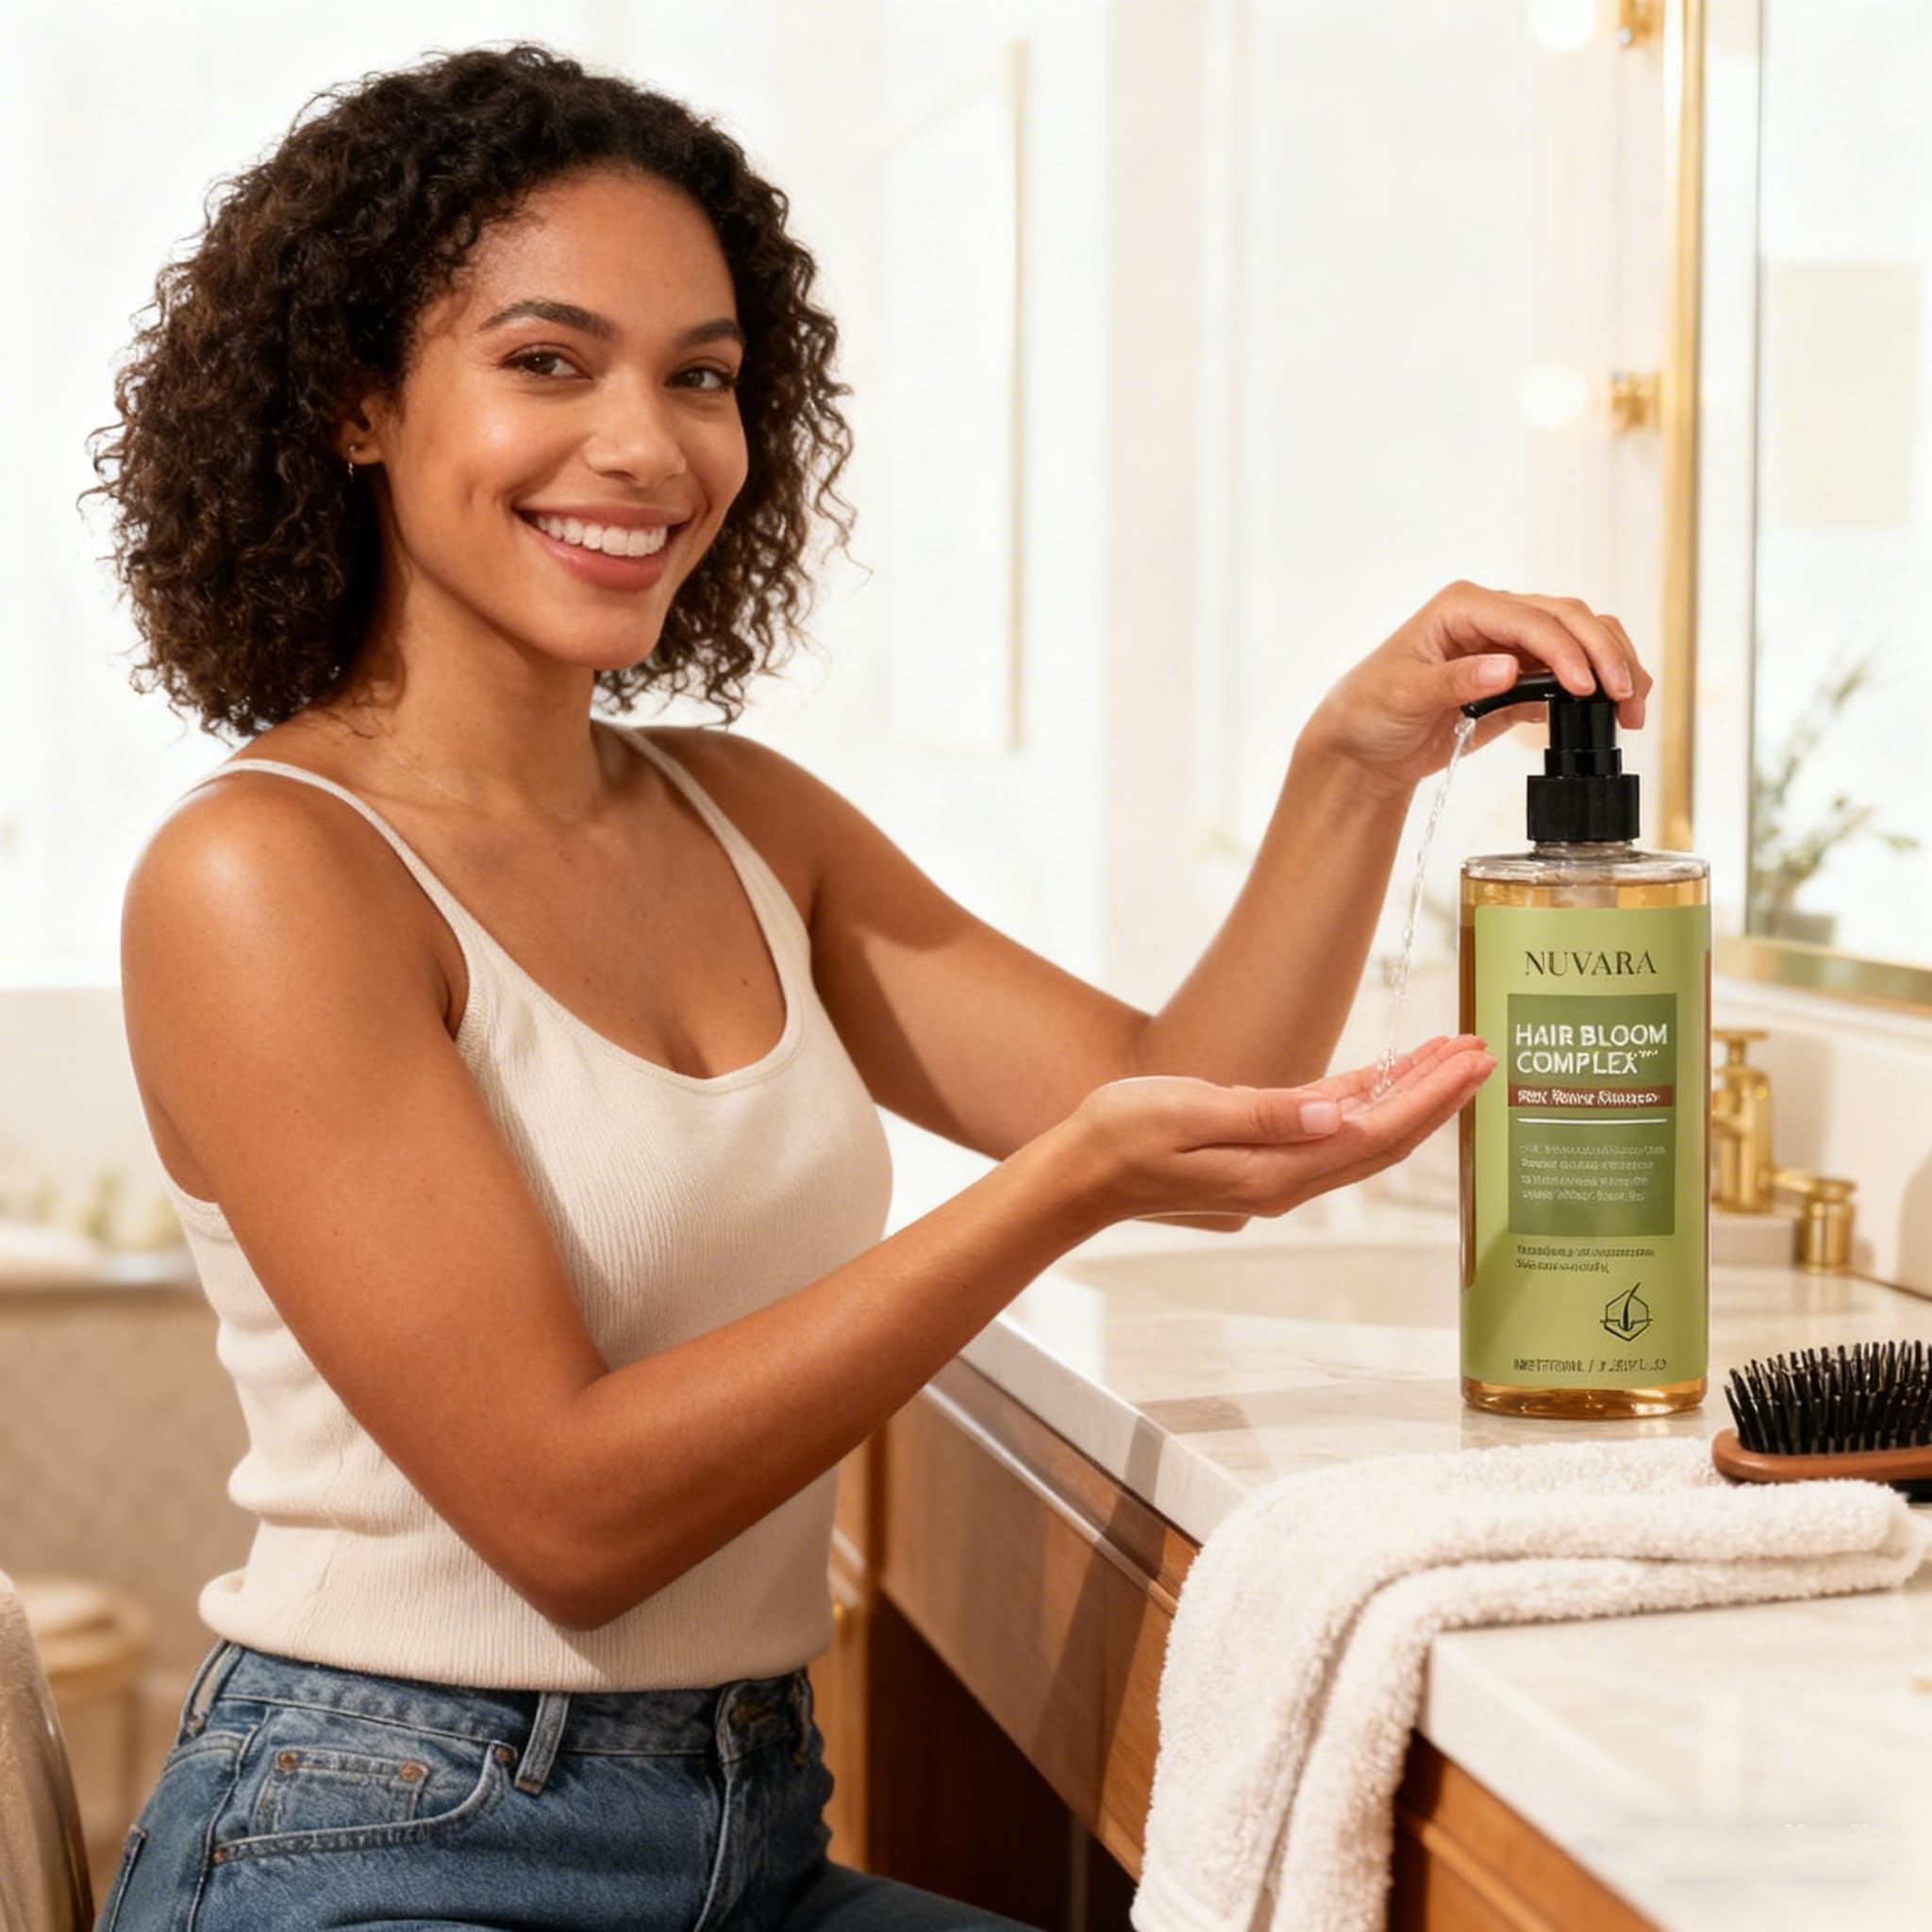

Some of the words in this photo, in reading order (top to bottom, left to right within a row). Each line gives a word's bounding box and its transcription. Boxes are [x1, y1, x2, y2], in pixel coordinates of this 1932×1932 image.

[1524, 950, 1657, 976] NUVARA
[1516, 1024, 1574, 1046] HAIR
[1580, 1024, 1668, 1047] BLOOM
